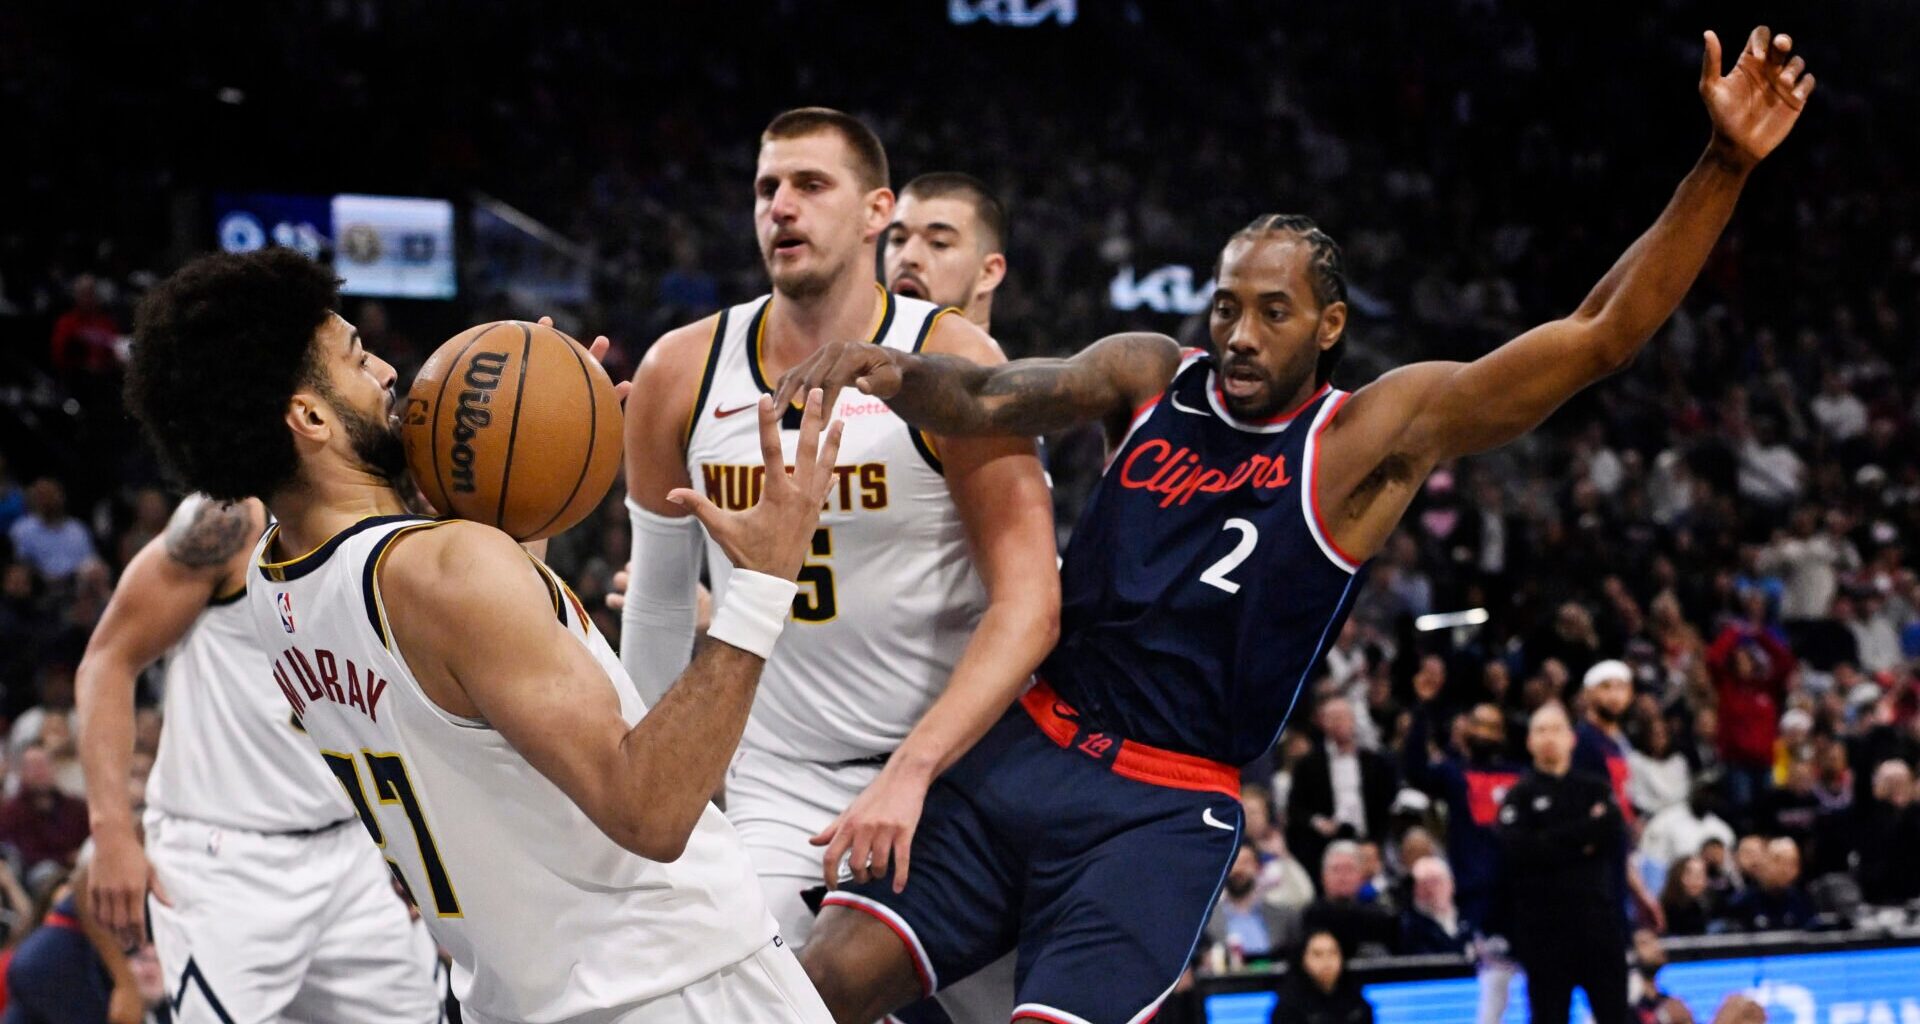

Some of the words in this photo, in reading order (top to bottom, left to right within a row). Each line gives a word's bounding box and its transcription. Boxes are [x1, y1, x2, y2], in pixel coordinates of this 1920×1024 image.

[450, 351, 510, 493] Wilson
[840, 402, 890, 417] ibotta
[1120, 438, 1292, 508] Clippers
[1199, 517, 1259, 594] 2
